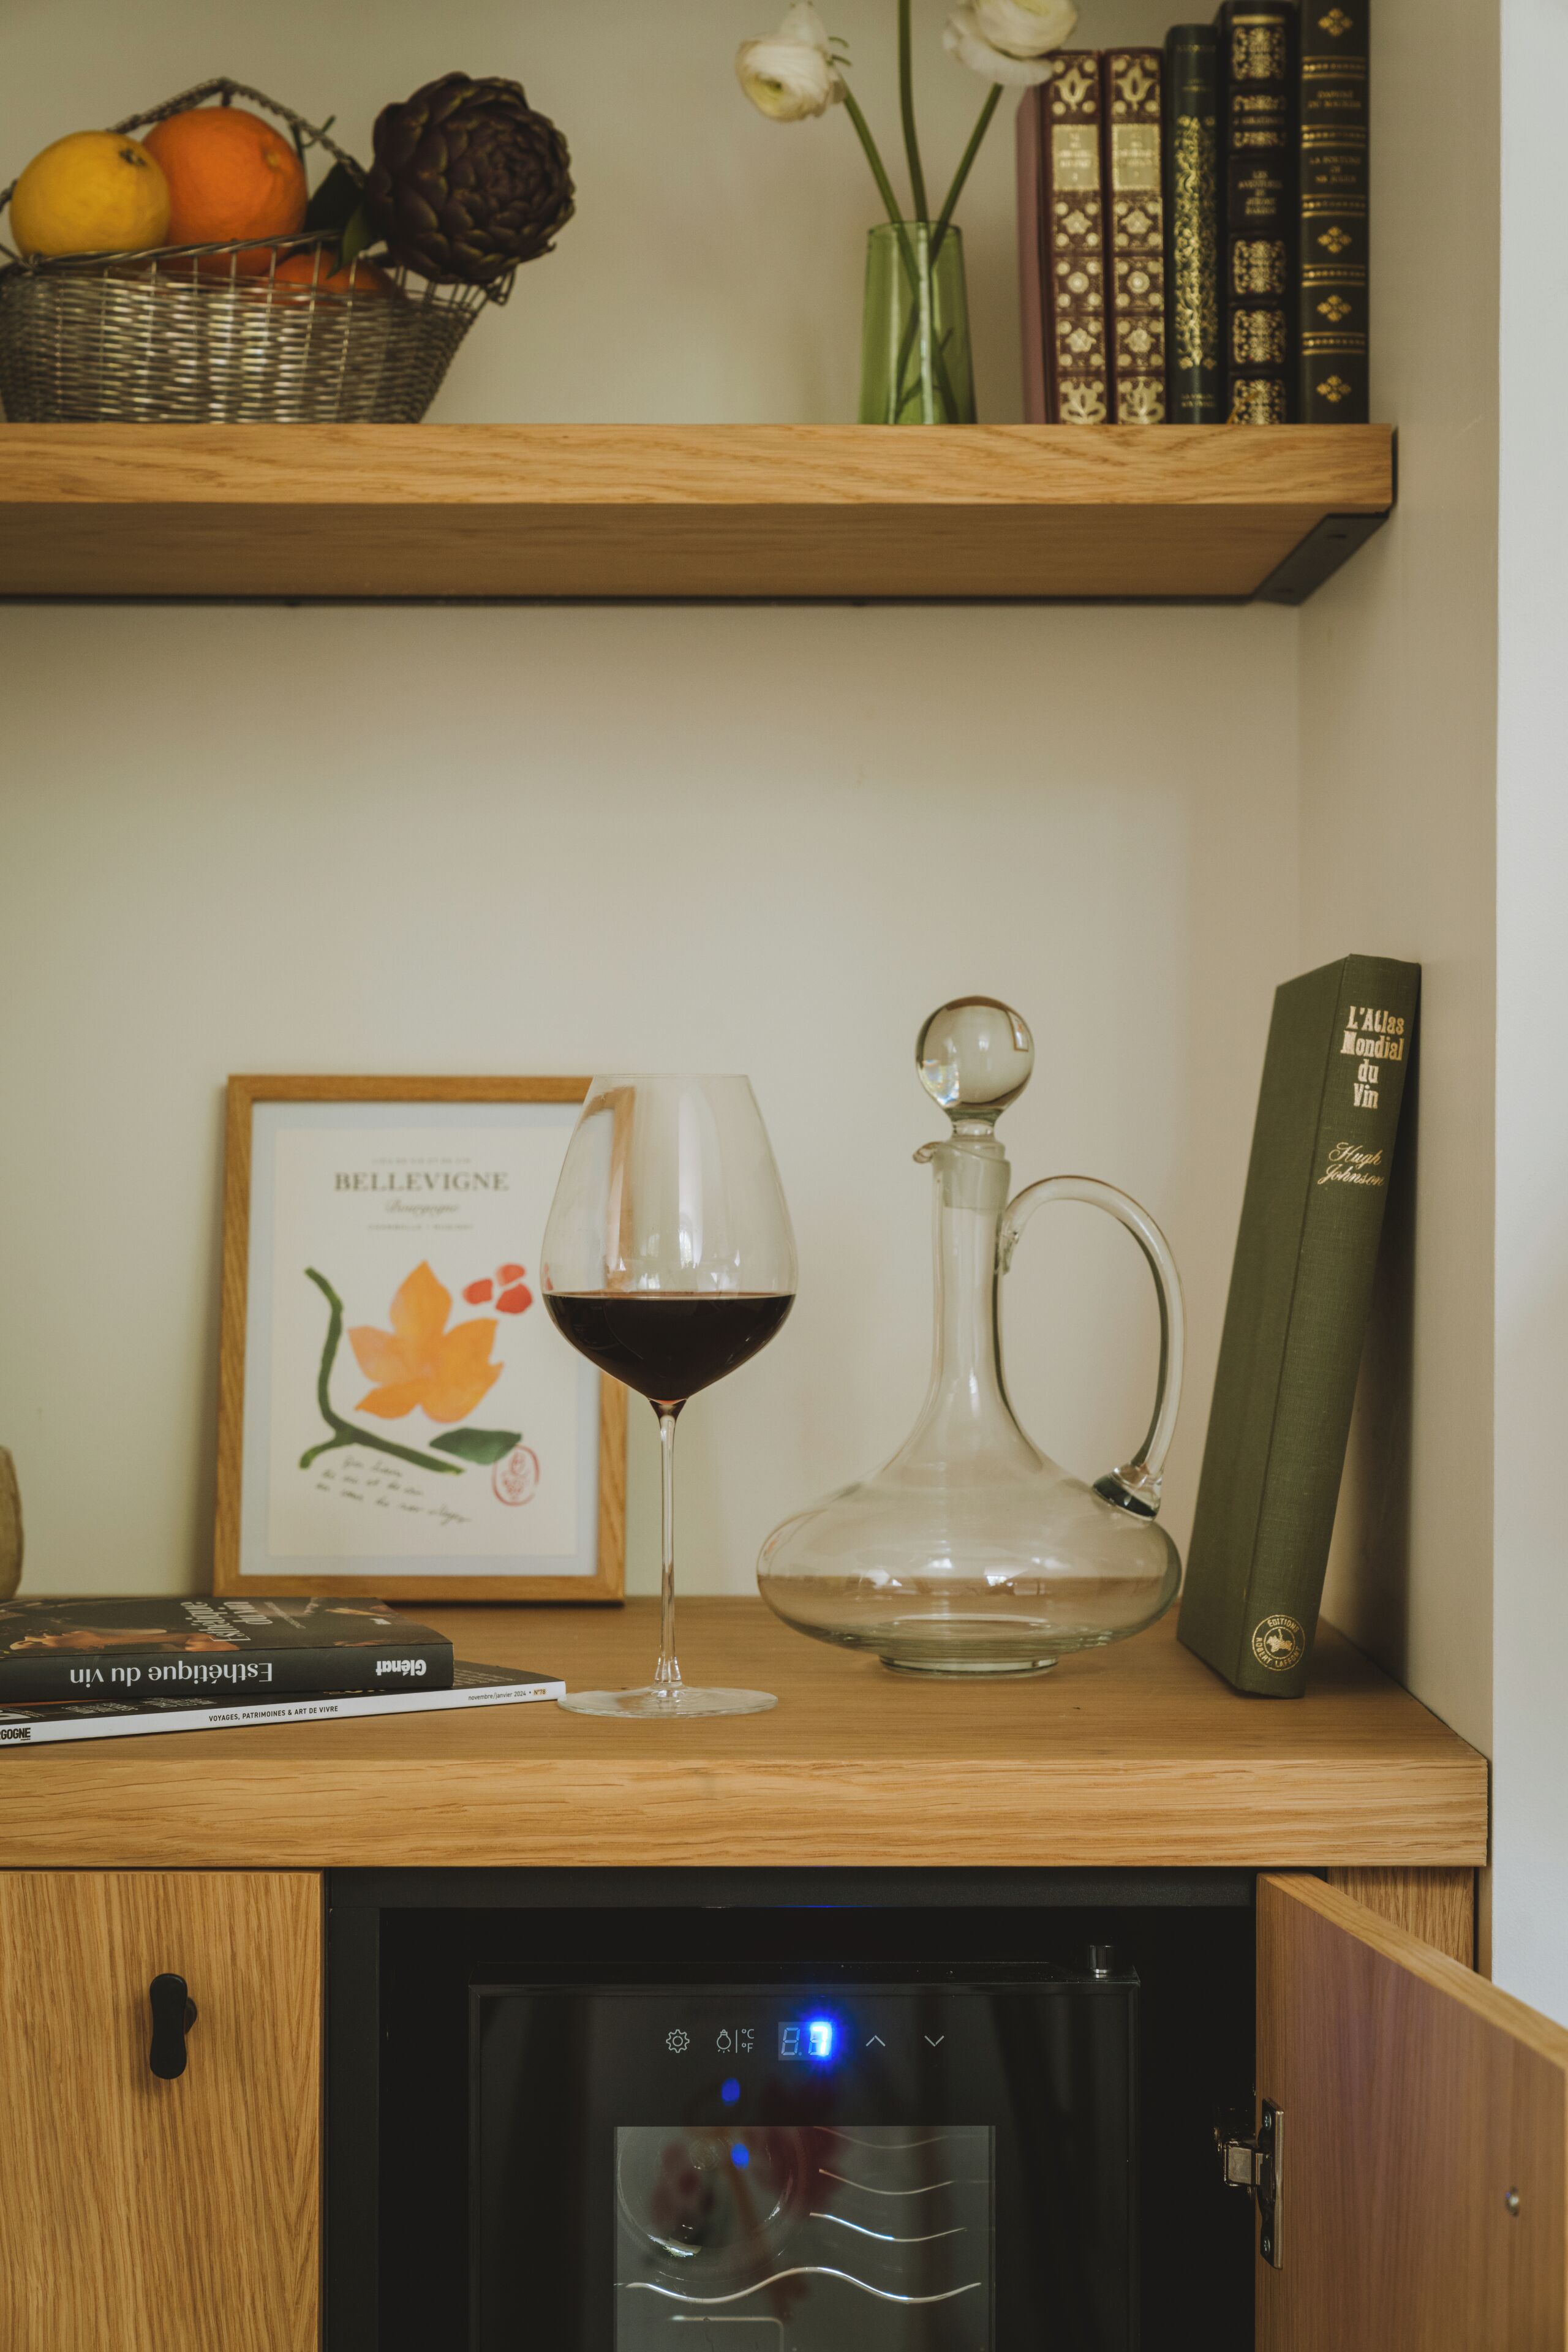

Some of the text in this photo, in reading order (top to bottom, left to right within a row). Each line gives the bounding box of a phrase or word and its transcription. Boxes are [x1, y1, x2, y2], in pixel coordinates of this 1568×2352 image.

[1346, 1005, 1404, 1035] L'Atlas
[1340, 1030, 1404, 1061] Mondial
[1357, 1059, 1379, 1084] du
[1354, 1083, 1379, 1109] Vin
[1329, 1142, 1383, 1170] Hugh
[334, 1172, 510, 1192] BELLEVIGNE
[1317, 1163, 1385, 1185] Johnson
[180, 1601, 251, 1642] Esthétique
[232, 1615, 273, 1625] du
[70, 1660, 273, 1688] Esthétique du vin
[375, 1659, 427, 1676] Glénat
[468, 1692, 512, 1701] novembre/janvier
[243, 1709, 286, 1719] PATRIMOINES
[0, 1727, 31, 1740] GOGNE
